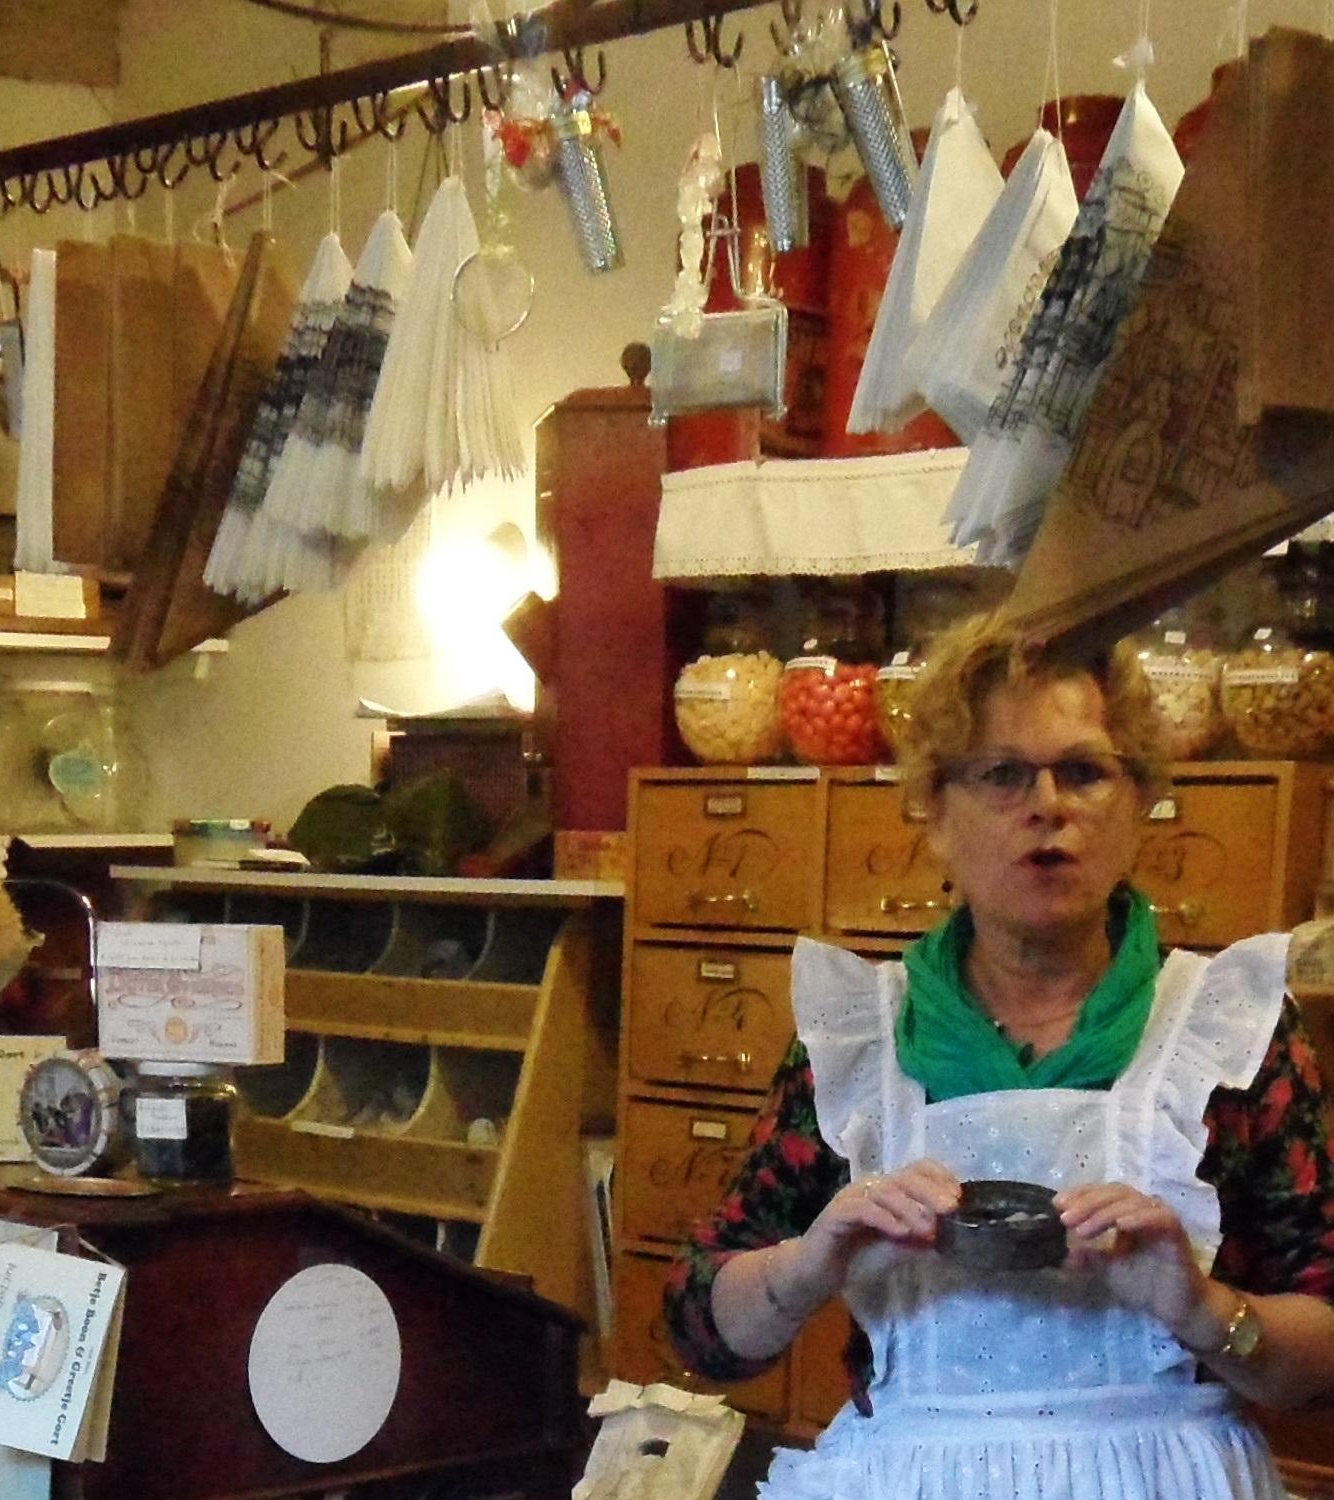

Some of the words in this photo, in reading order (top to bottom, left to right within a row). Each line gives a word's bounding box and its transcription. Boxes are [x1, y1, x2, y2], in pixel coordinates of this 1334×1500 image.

[89, 1272, 107, 1302] Betje
[78, 1309, 96, 1342] Boon
[61, 1361, 81, 1410] Greetje
[51, 1414, 67, 1446] Gort
